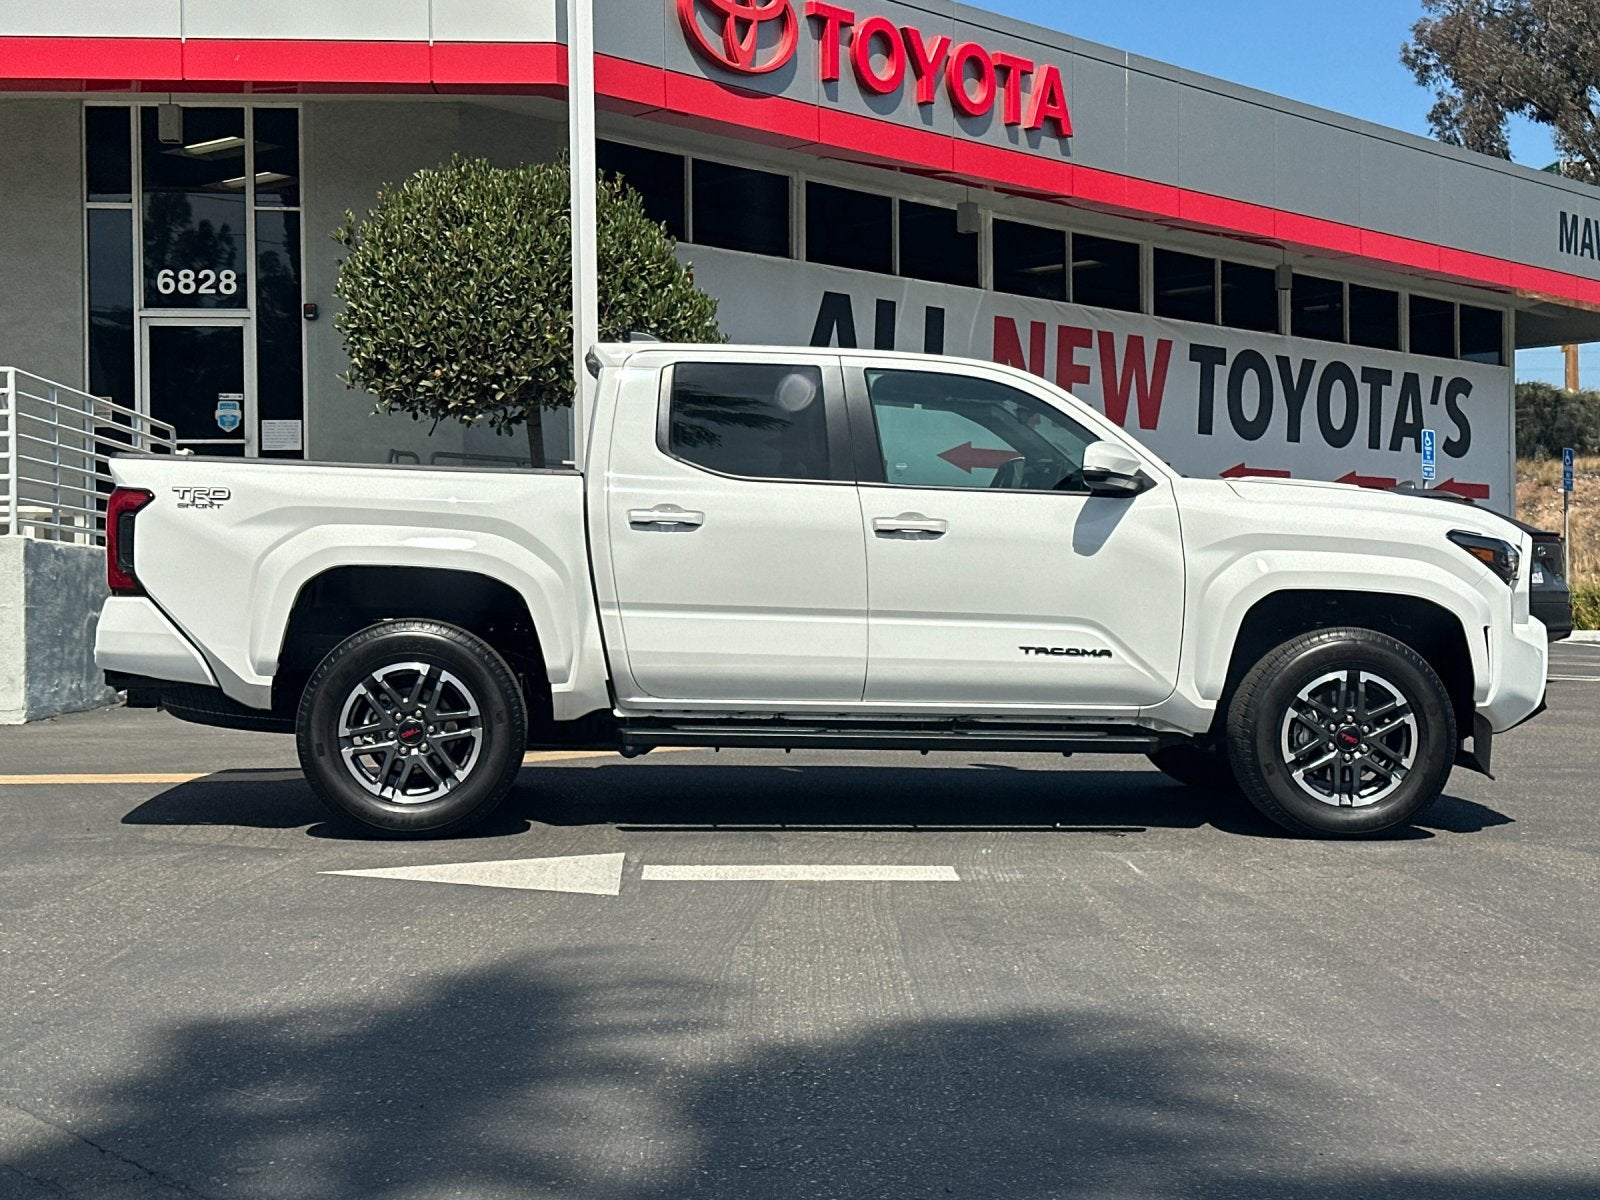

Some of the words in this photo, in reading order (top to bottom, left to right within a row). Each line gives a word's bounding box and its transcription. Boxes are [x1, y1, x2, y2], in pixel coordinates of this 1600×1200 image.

[805, 0, 1073, 138] TOYOTA
[157, 269, 238, 295] 6828
[1189, 343, 1472, 458] TOYOTA'S
[172, 486, 231, 503] TRD
[1018, 646, 1112, 658] TACOMA
